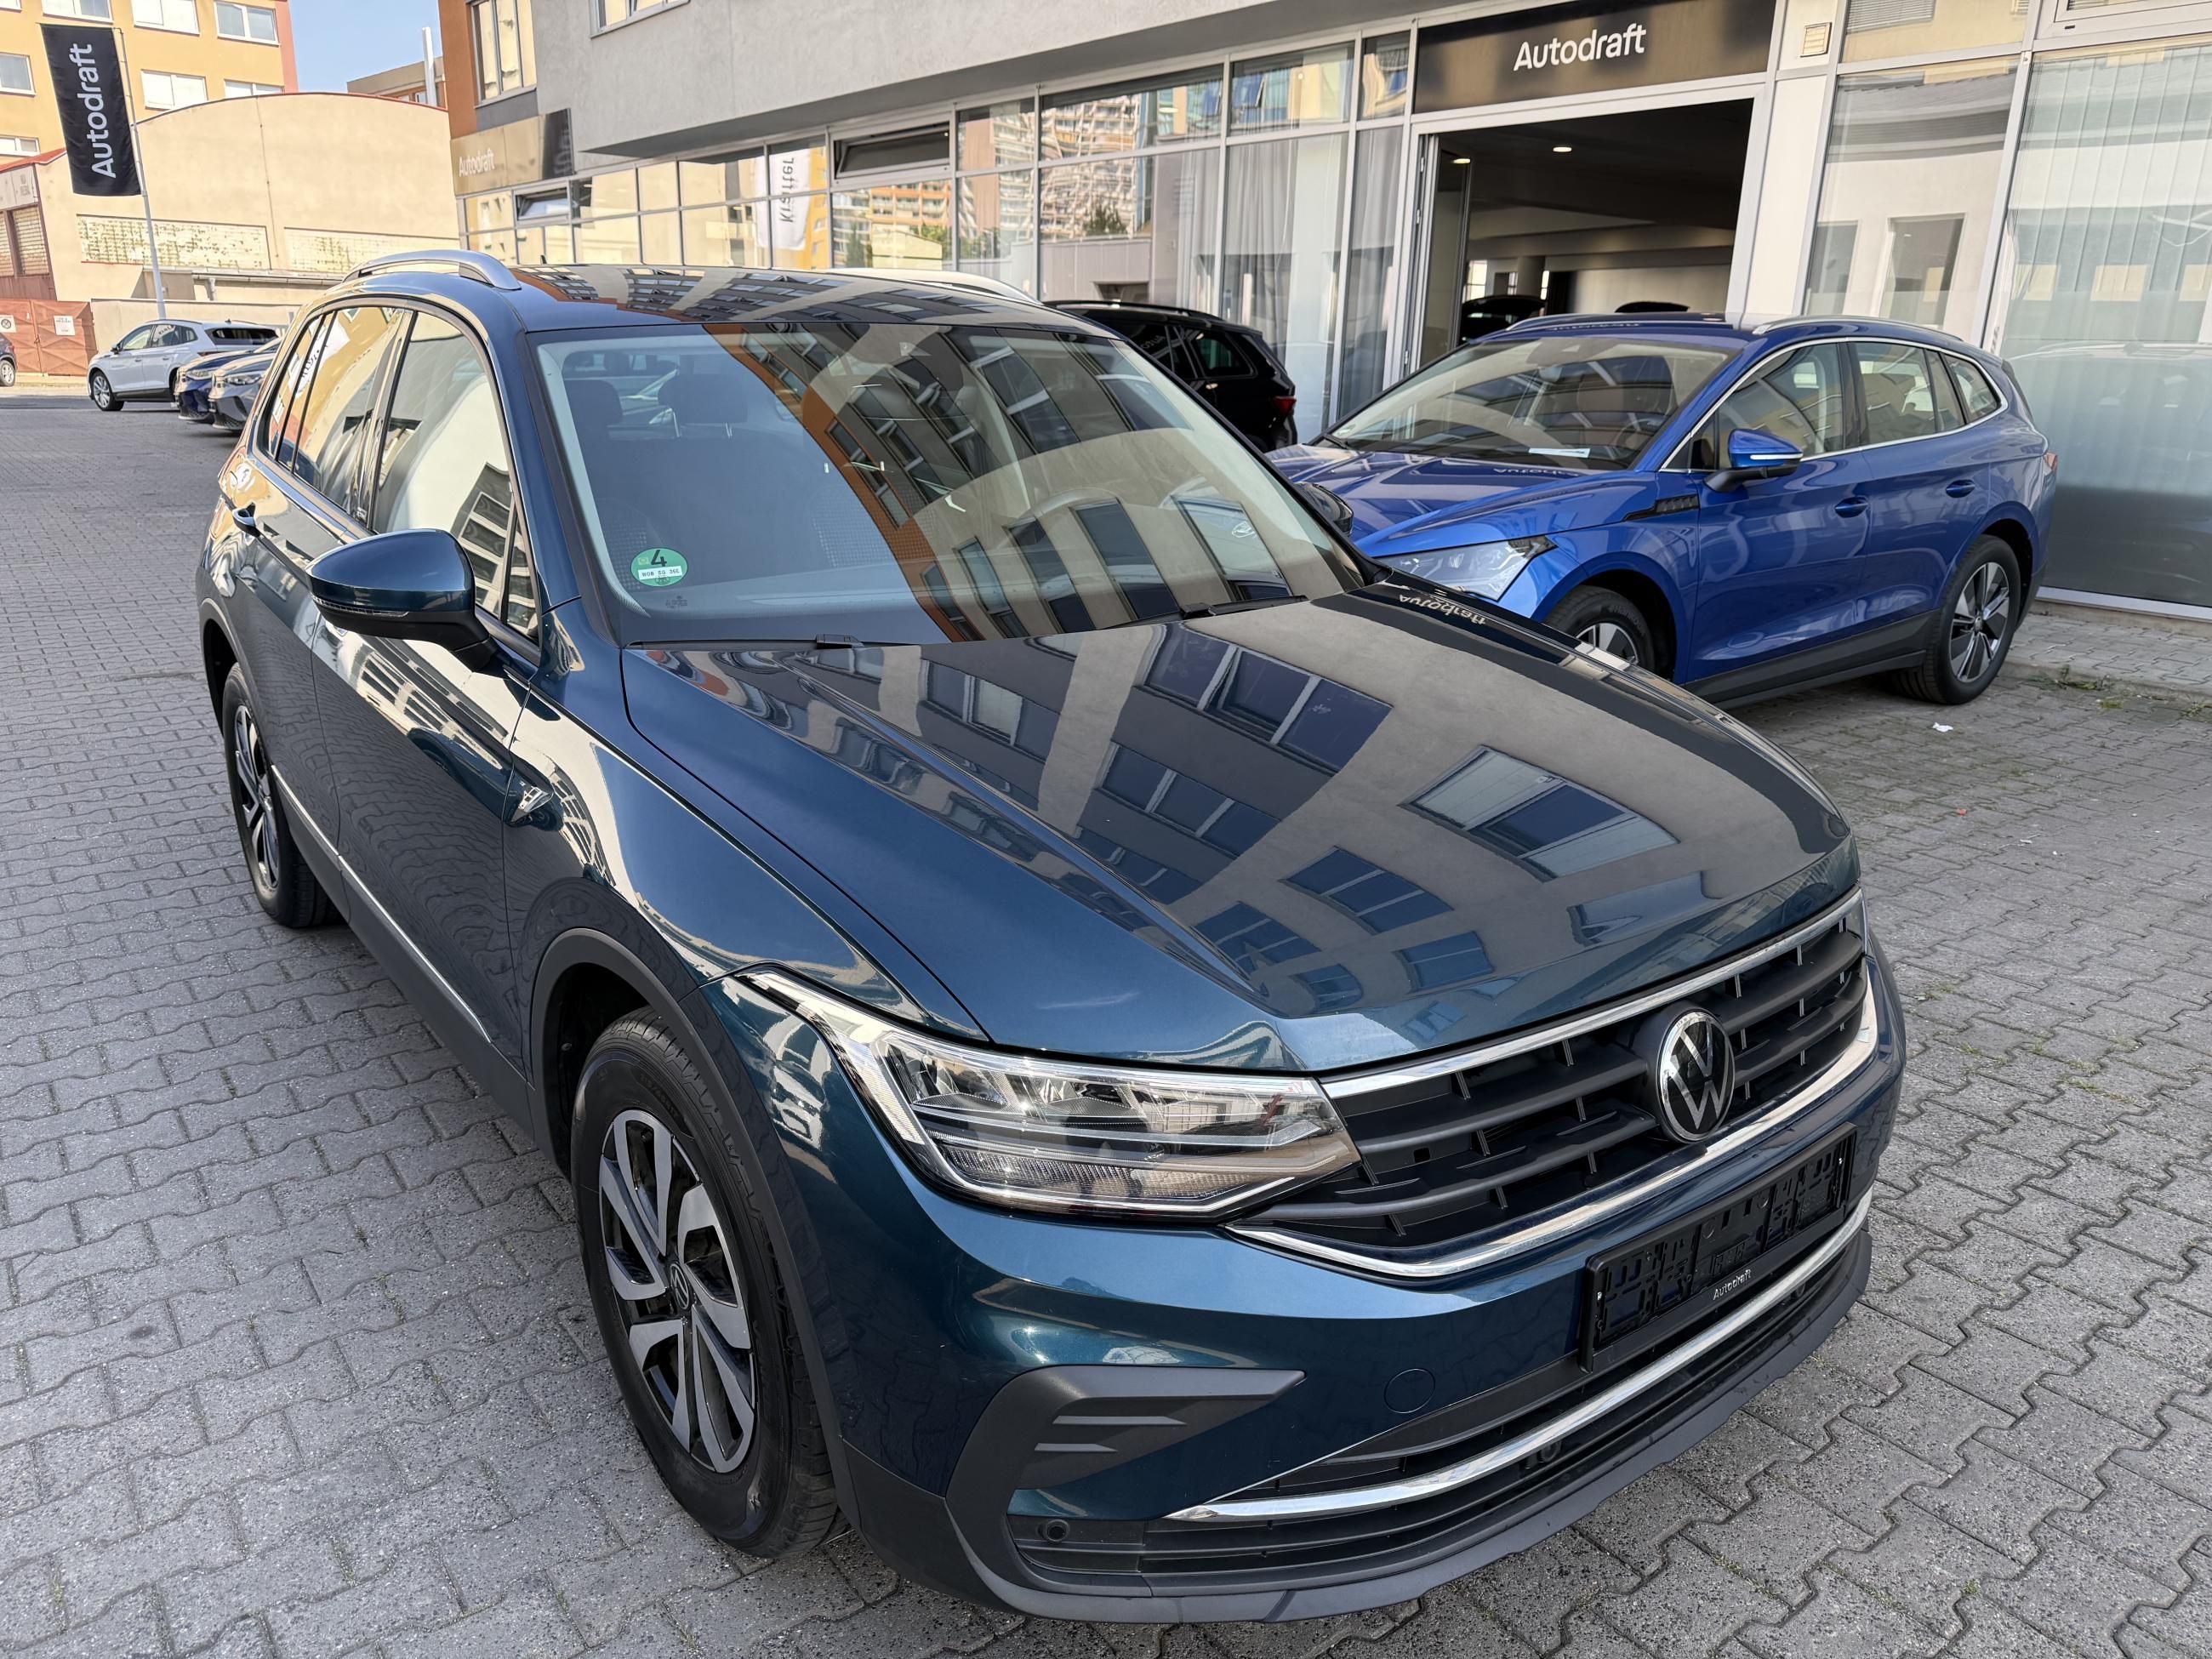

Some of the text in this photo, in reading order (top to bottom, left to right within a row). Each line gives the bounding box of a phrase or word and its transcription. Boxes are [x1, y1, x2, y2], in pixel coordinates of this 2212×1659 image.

[1513, 22, 1647, 71] Autodraft
[68, 43, 117, 179] Autodraft
[459, 147, 495, 177] Autodraft
[650, 549, 668, 567] 4
[1713, 1268, 1752, 1301] Autodraft
